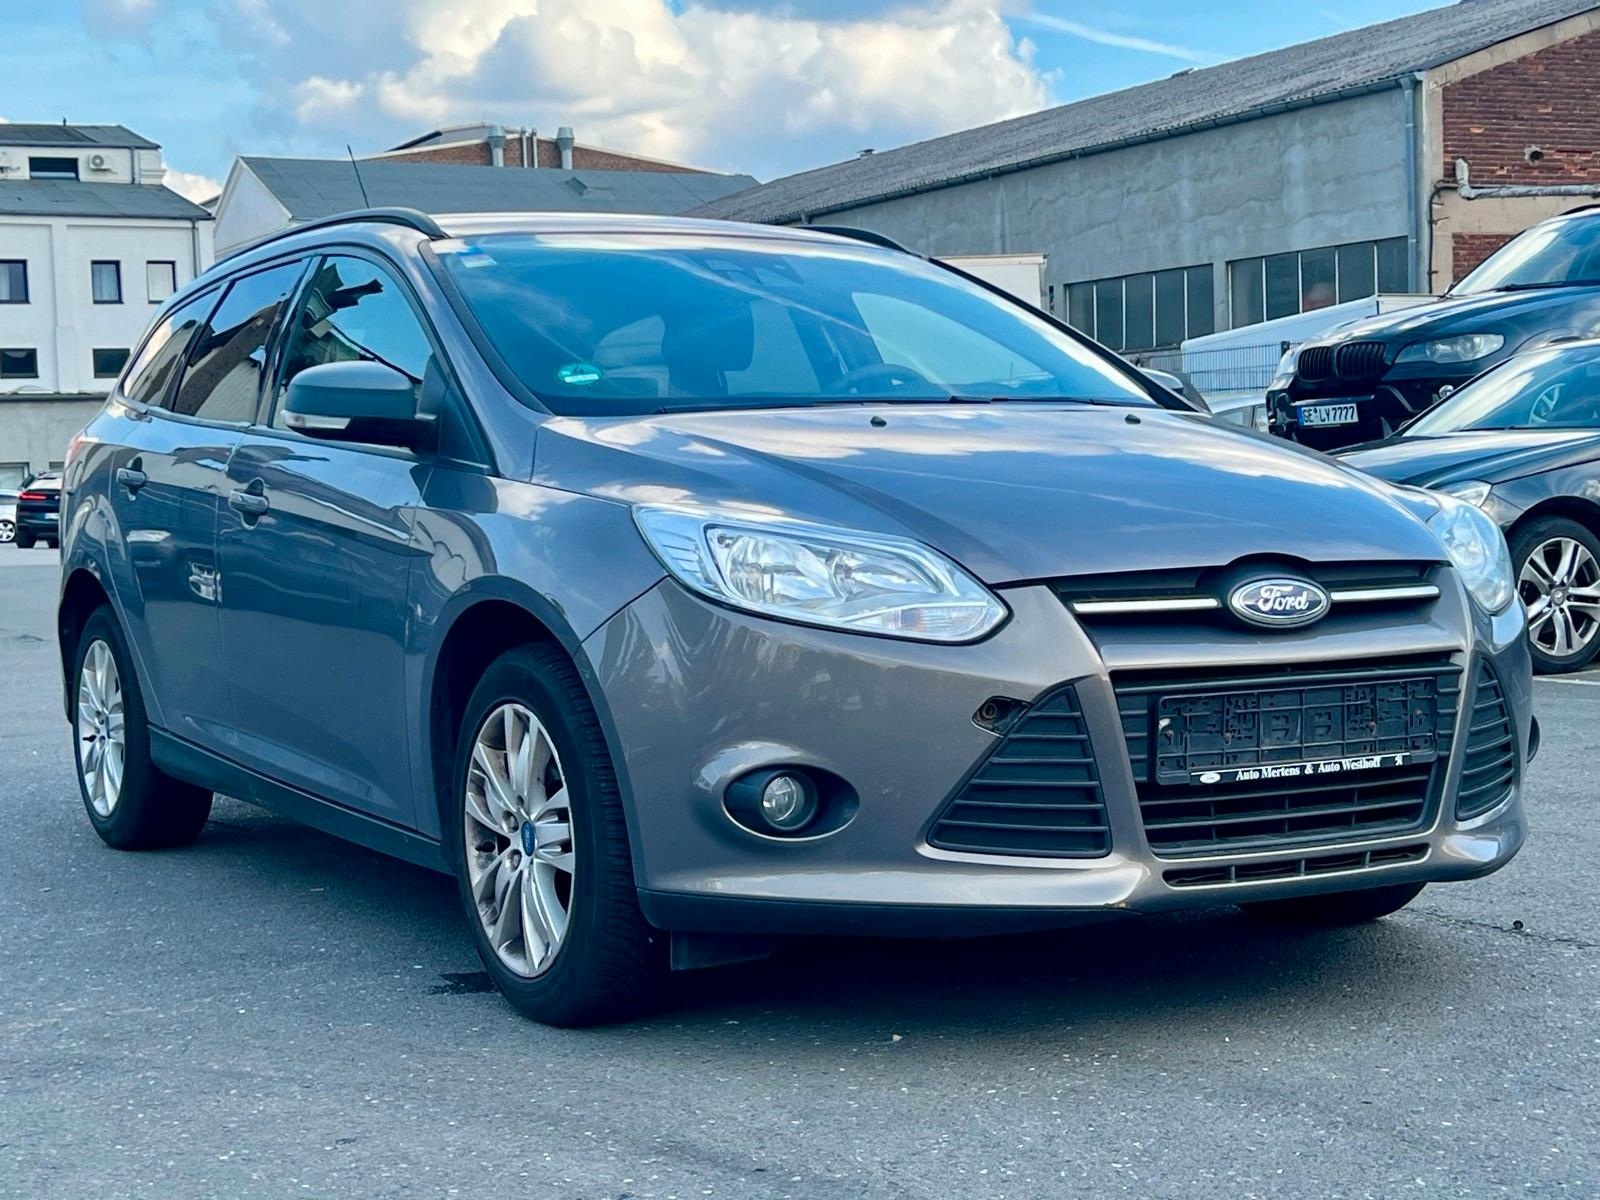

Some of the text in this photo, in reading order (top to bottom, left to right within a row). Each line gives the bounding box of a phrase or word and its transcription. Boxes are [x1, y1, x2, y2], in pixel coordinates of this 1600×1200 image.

[1258, 585, 1309, 612] Ford
[1236, 768, 1260, 781] Auto
[1261, 766, 1300, 779] Mertens
[1304, 763, 1314, 775] &
[1317, 761, 1340, 774] Auto
